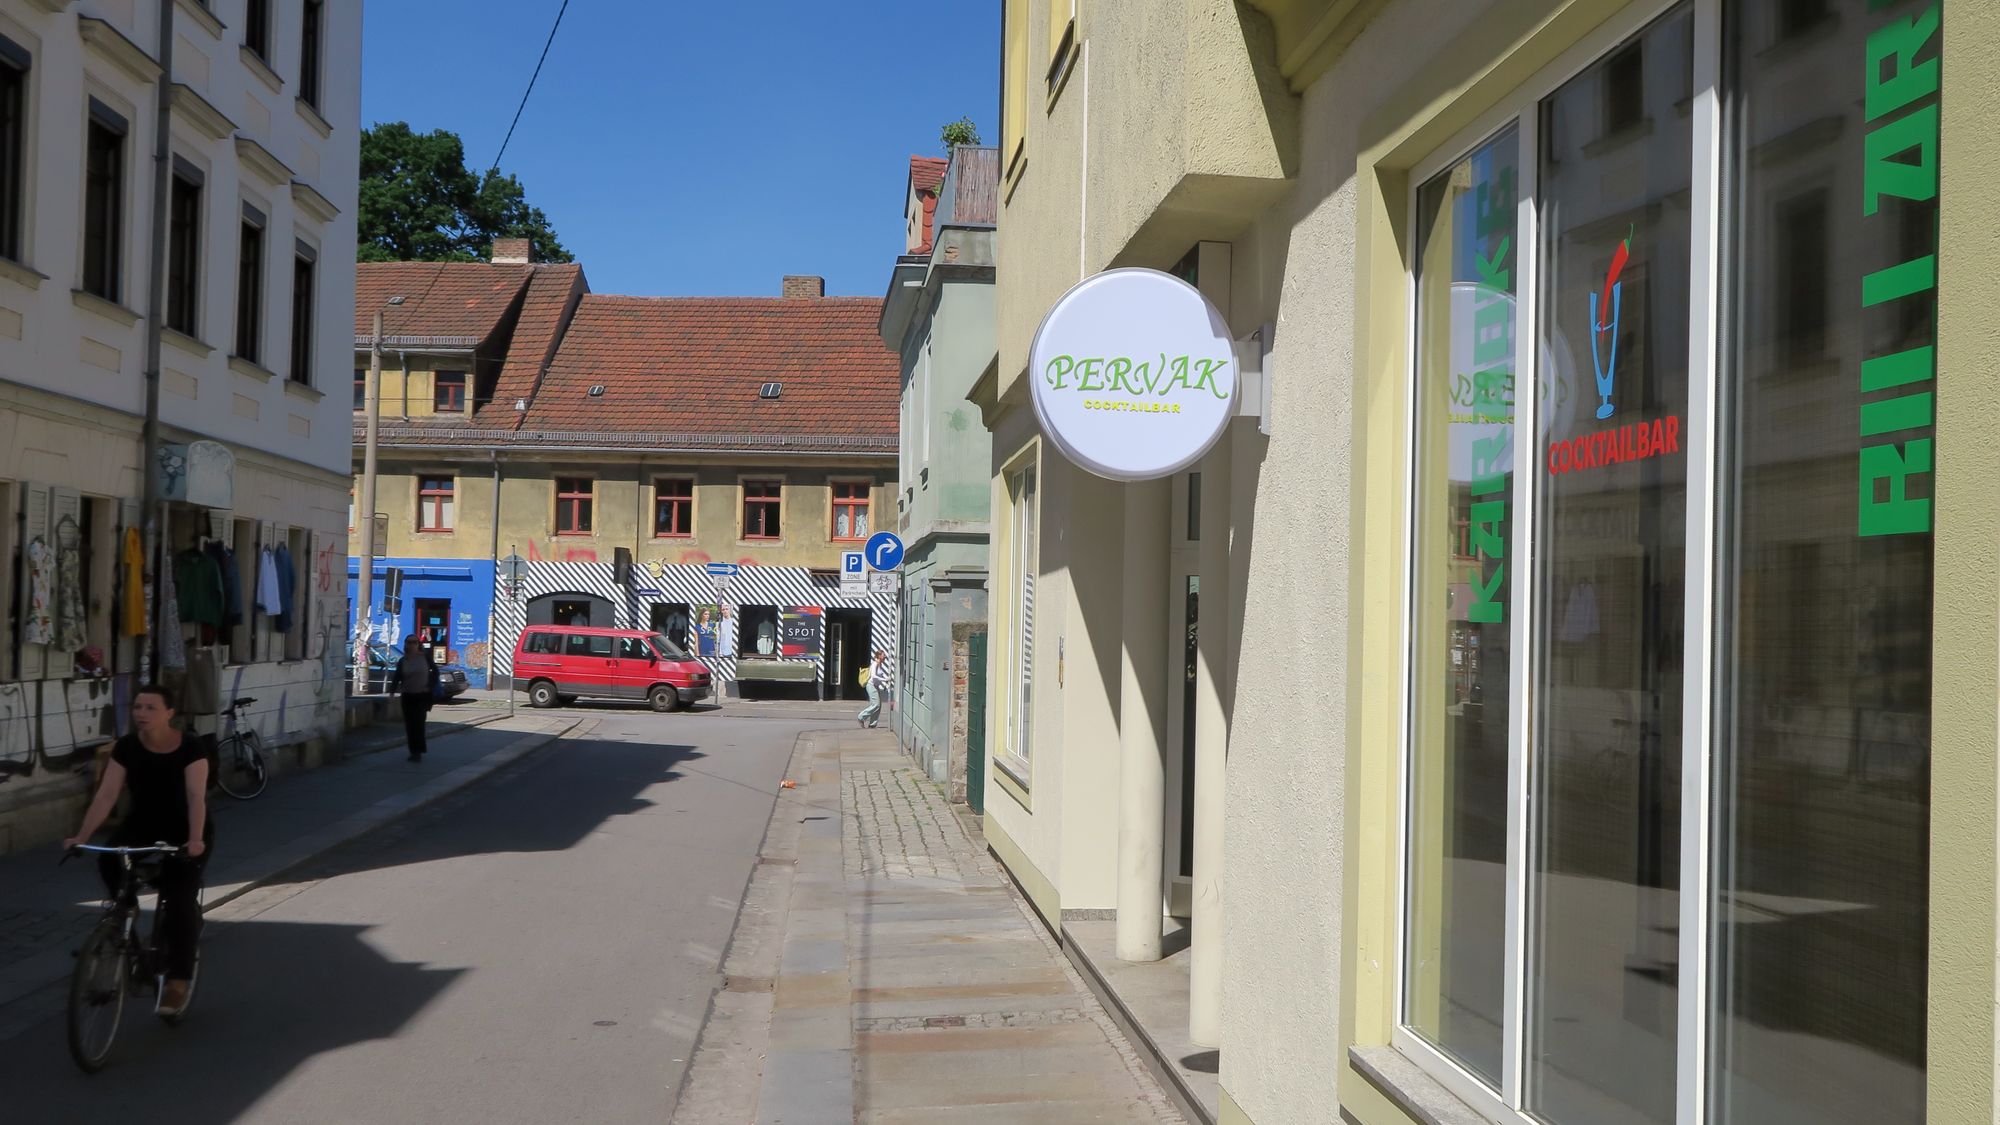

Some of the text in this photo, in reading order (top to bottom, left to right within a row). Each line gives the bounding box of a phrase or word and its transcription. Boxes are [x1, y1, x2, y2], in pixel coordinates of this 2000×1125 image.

[1046, 353, 1229, 399] PERVAK
[1083, 400, 1181, 414] COCKTAILBAR
[1548, 415, 1680, 475] COCKTAILBAR
[849, 556, 859, 570] P
[787, 627, 815, 637] SPOT
